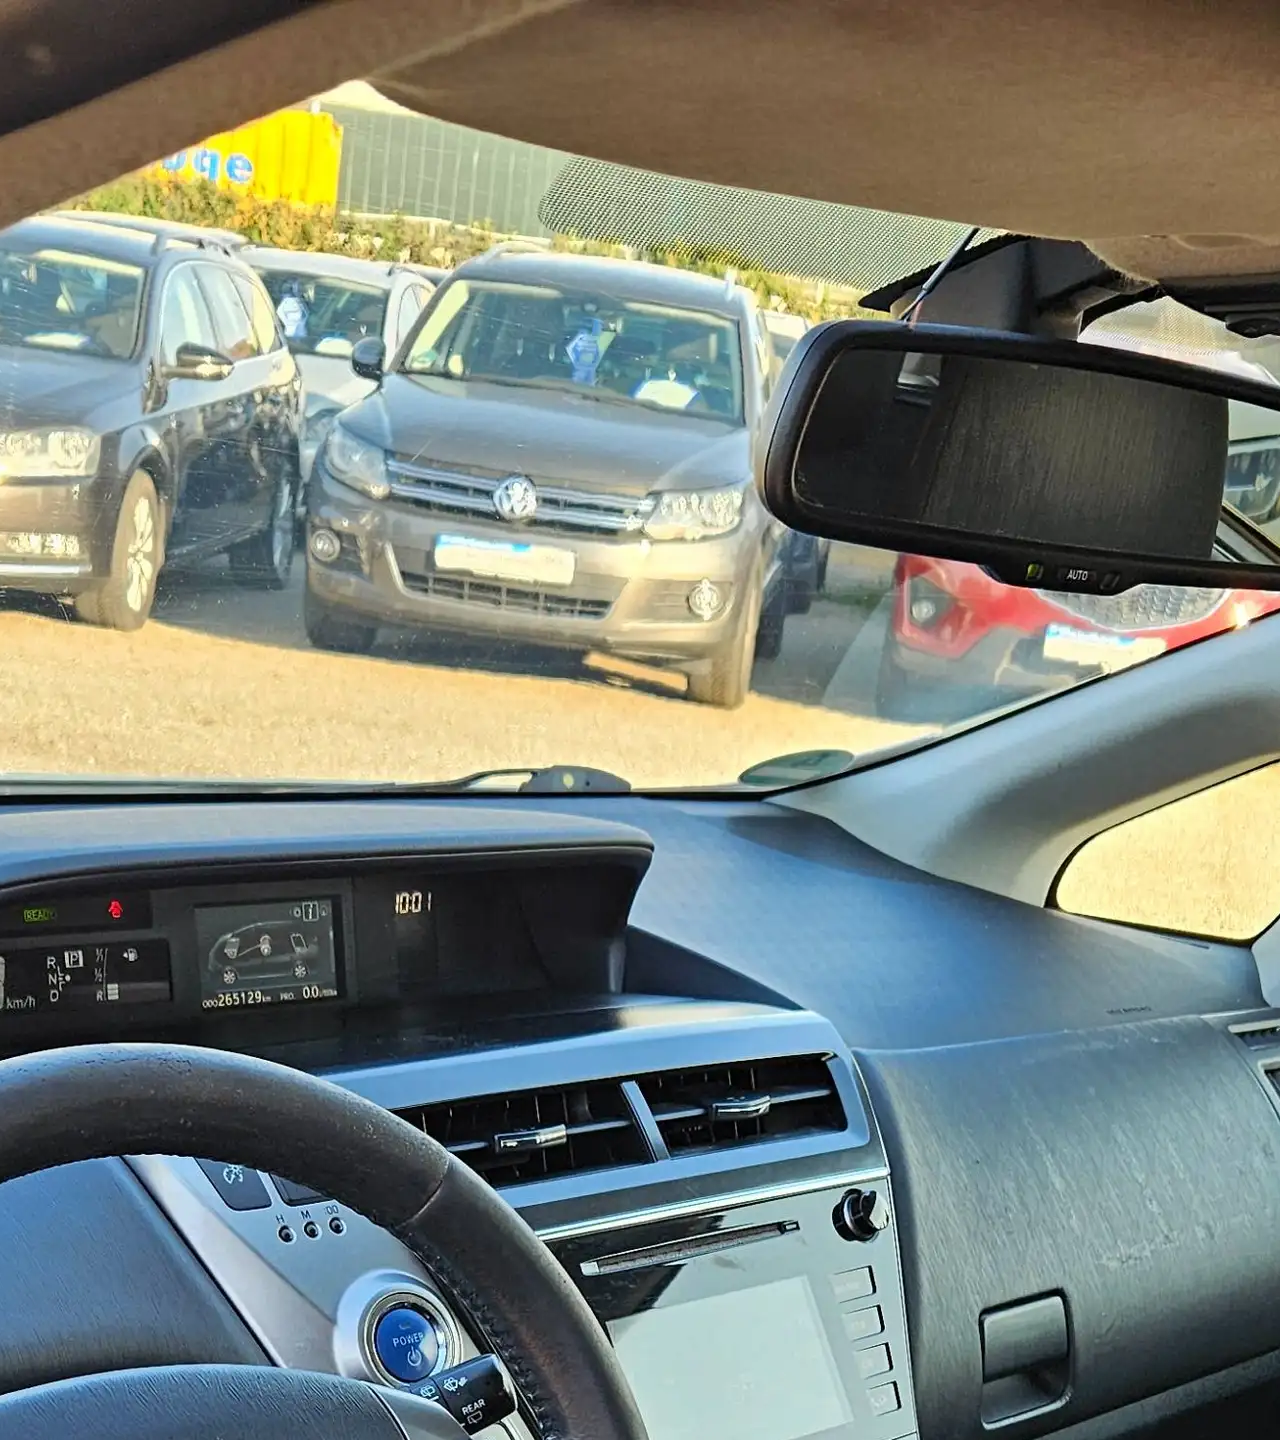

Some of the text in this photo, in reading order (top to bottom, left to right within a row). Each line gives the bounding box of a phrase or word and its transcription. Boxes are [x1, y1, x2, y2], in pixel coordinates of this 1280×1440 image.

[1066, 569, 1089, 581] AUTO
[394, 891, 433, 914] 10:01
[6, 995, 37, 1010] km/h
[392, 1331, 426, 1348] POWER
[461, 1398, 486, 1416] REAR
